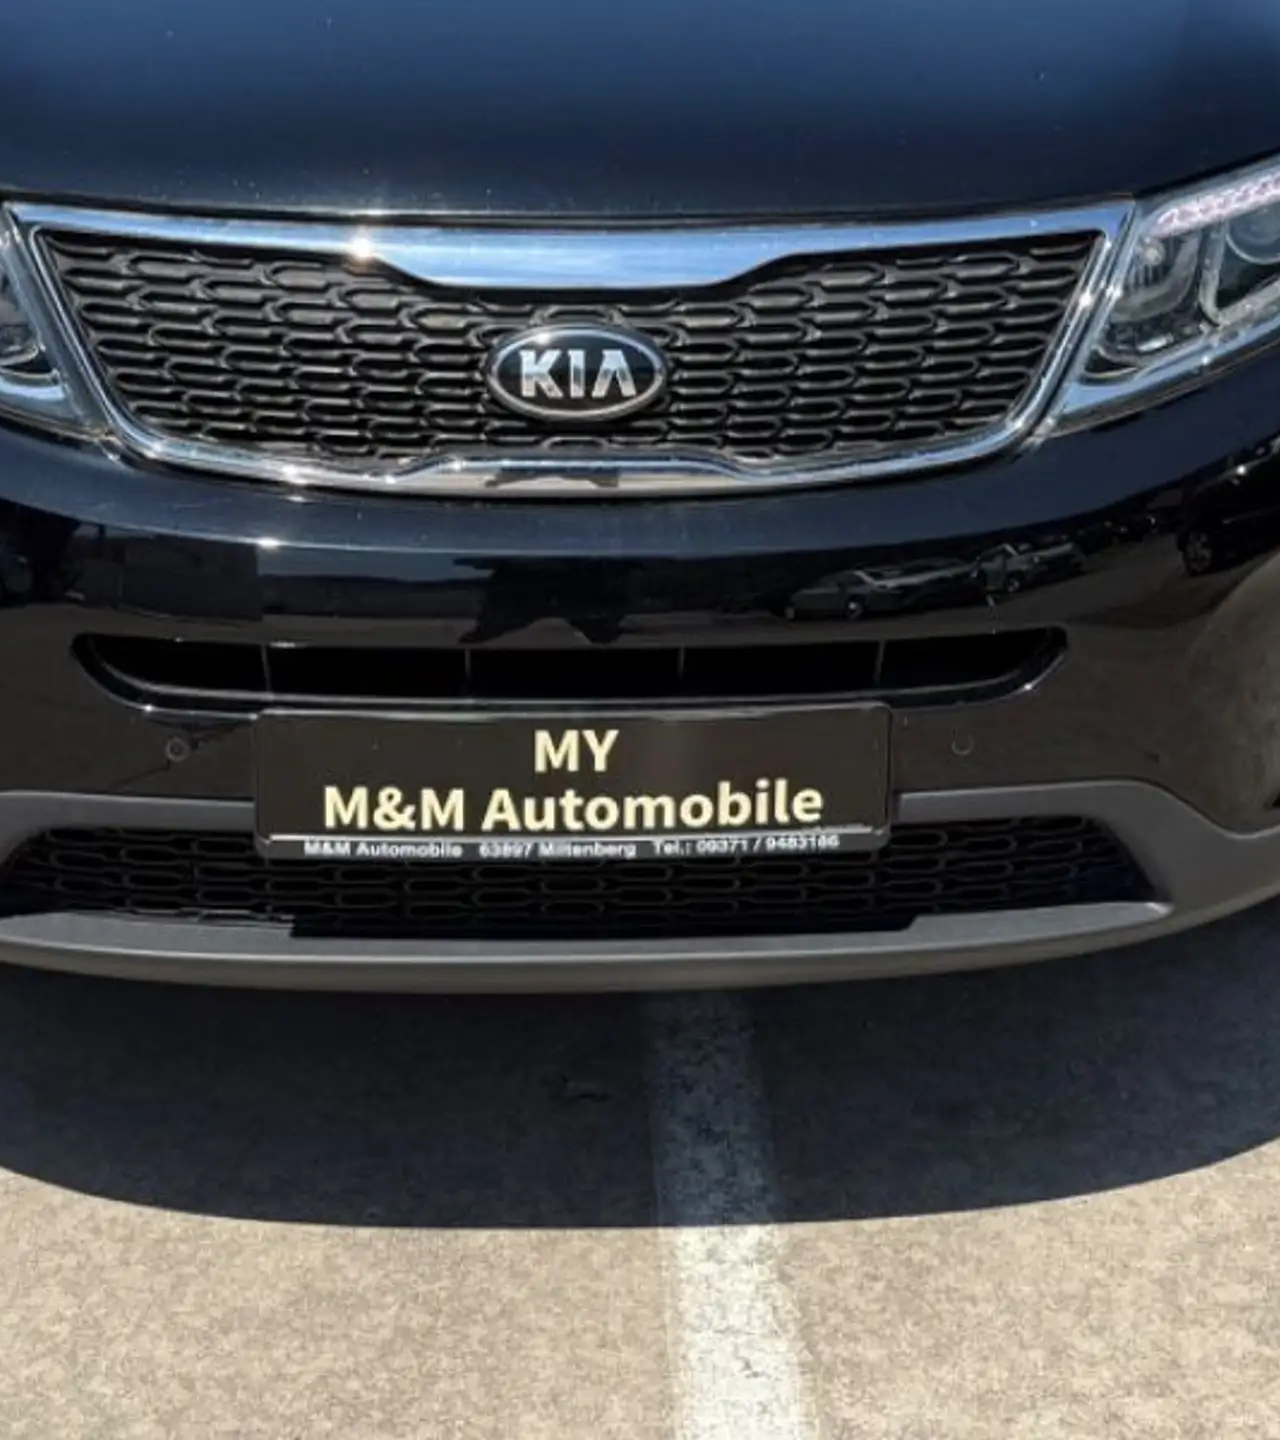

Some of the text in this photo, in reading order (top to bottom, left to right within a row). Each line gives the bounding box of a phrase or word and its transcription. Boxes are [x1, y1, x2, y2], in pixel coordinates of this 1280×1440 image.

[520, 348, 637, 398] KIA
[534, 729, 619, 773] MY
[324, 778, 824, 831] M&M Automobile
[304, 840, 351, 856] M&M
[356, 841, 462, 859] Automobile
